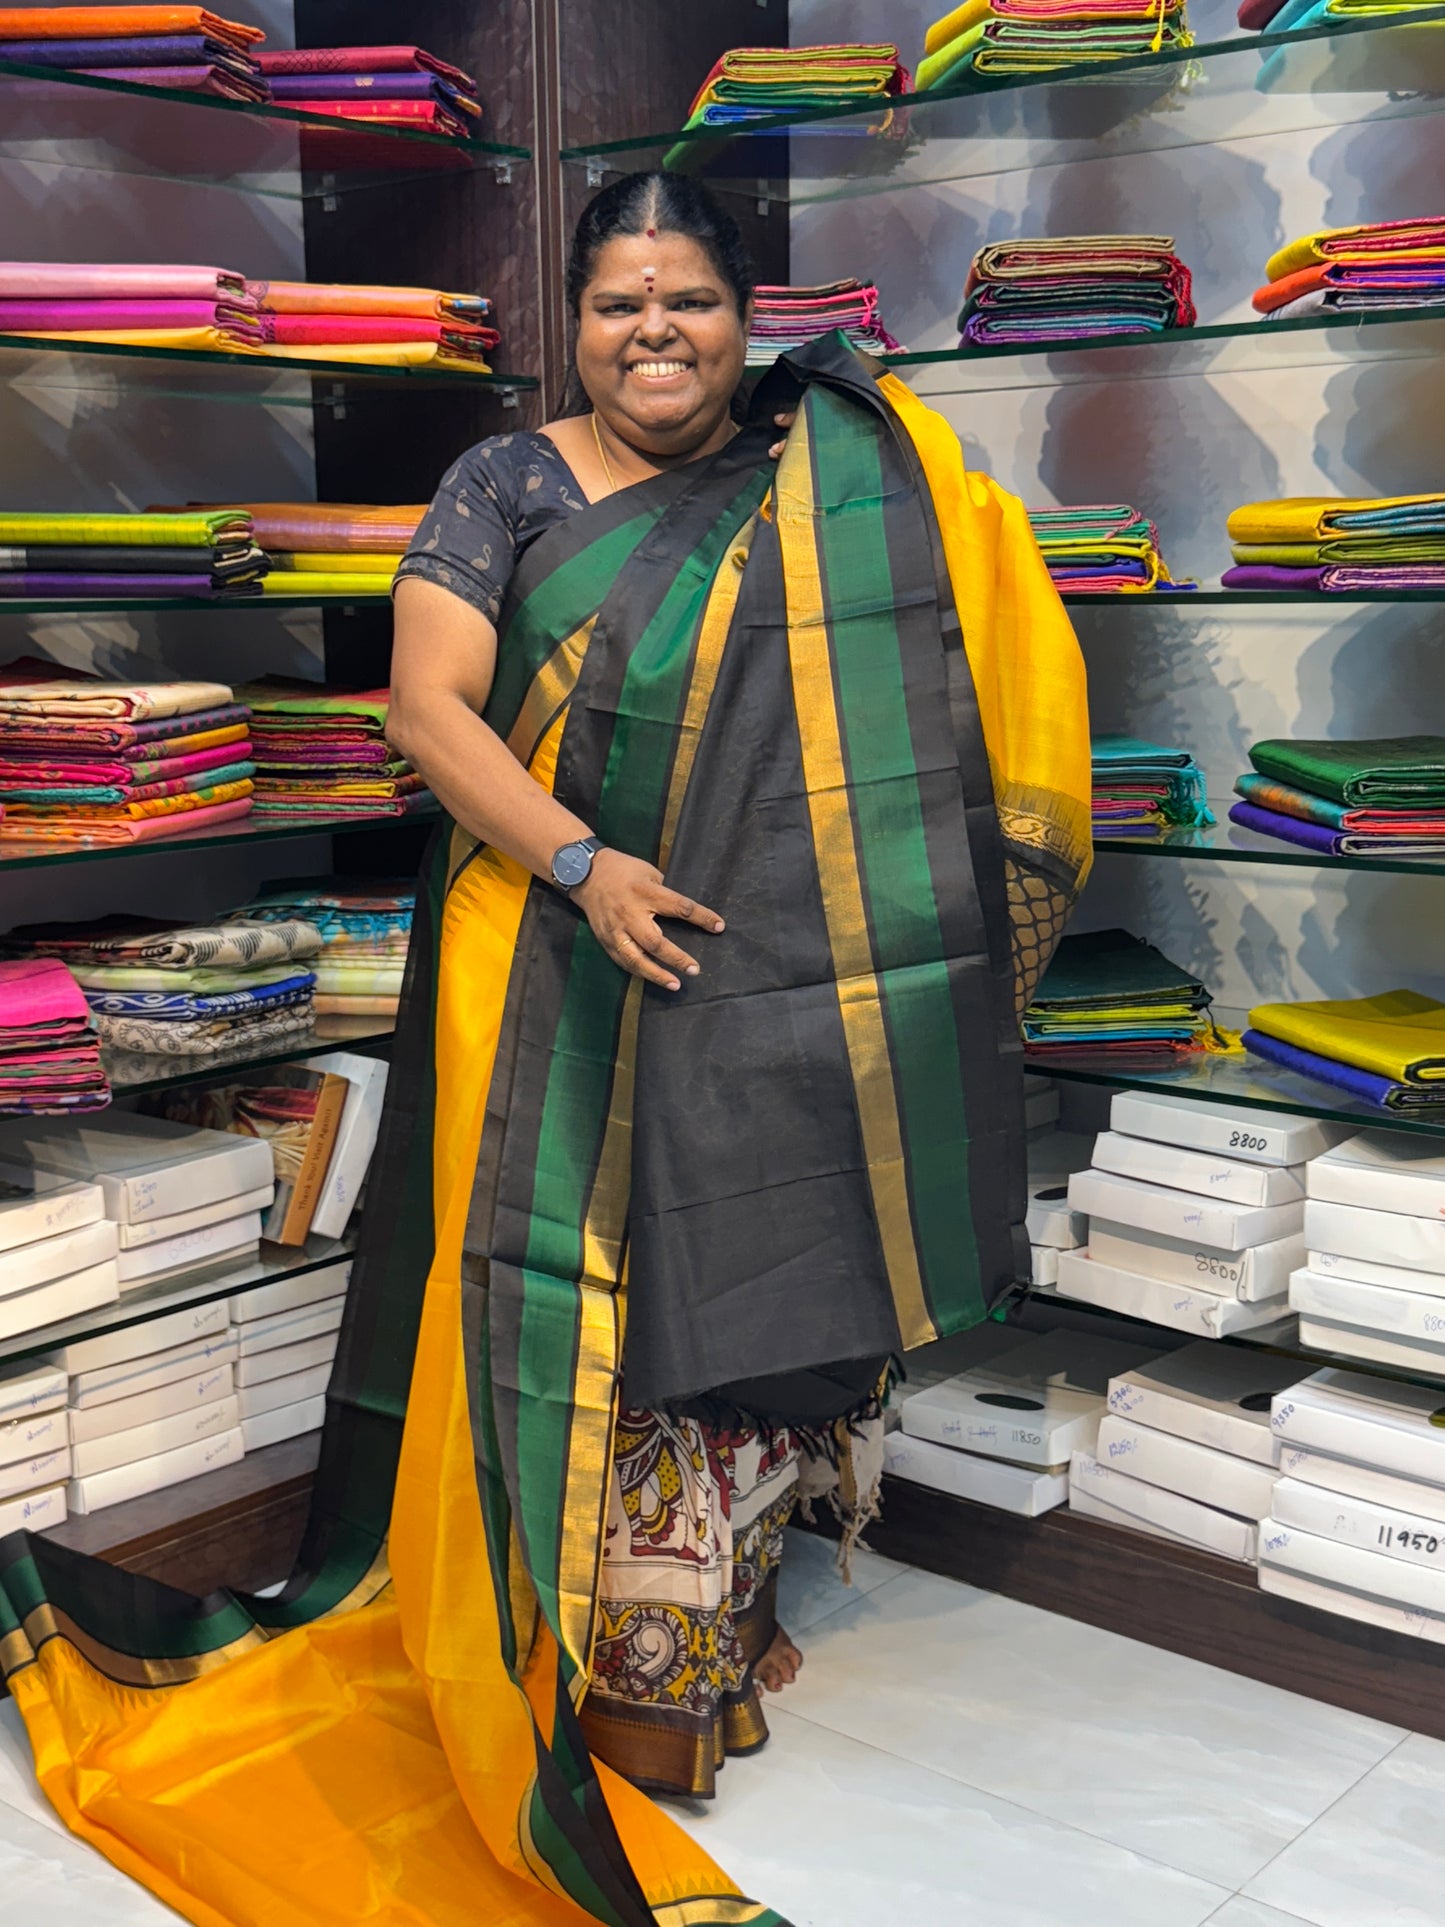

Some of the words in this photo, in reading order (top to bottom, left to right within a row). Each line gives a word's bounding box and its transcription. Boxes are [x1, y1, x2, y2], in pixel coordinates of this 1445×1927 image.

[1228, 1130, 1268, 1152] 8800
[298, 1184, 312, 1210] Thank
[312, 1141, 324, 1161] Visit
[1271, 1403, 1295, 1429] 9350
[1011, 1429, 1042, 1446] 11850
[1377, 1525, 1439, 1554] 11950
